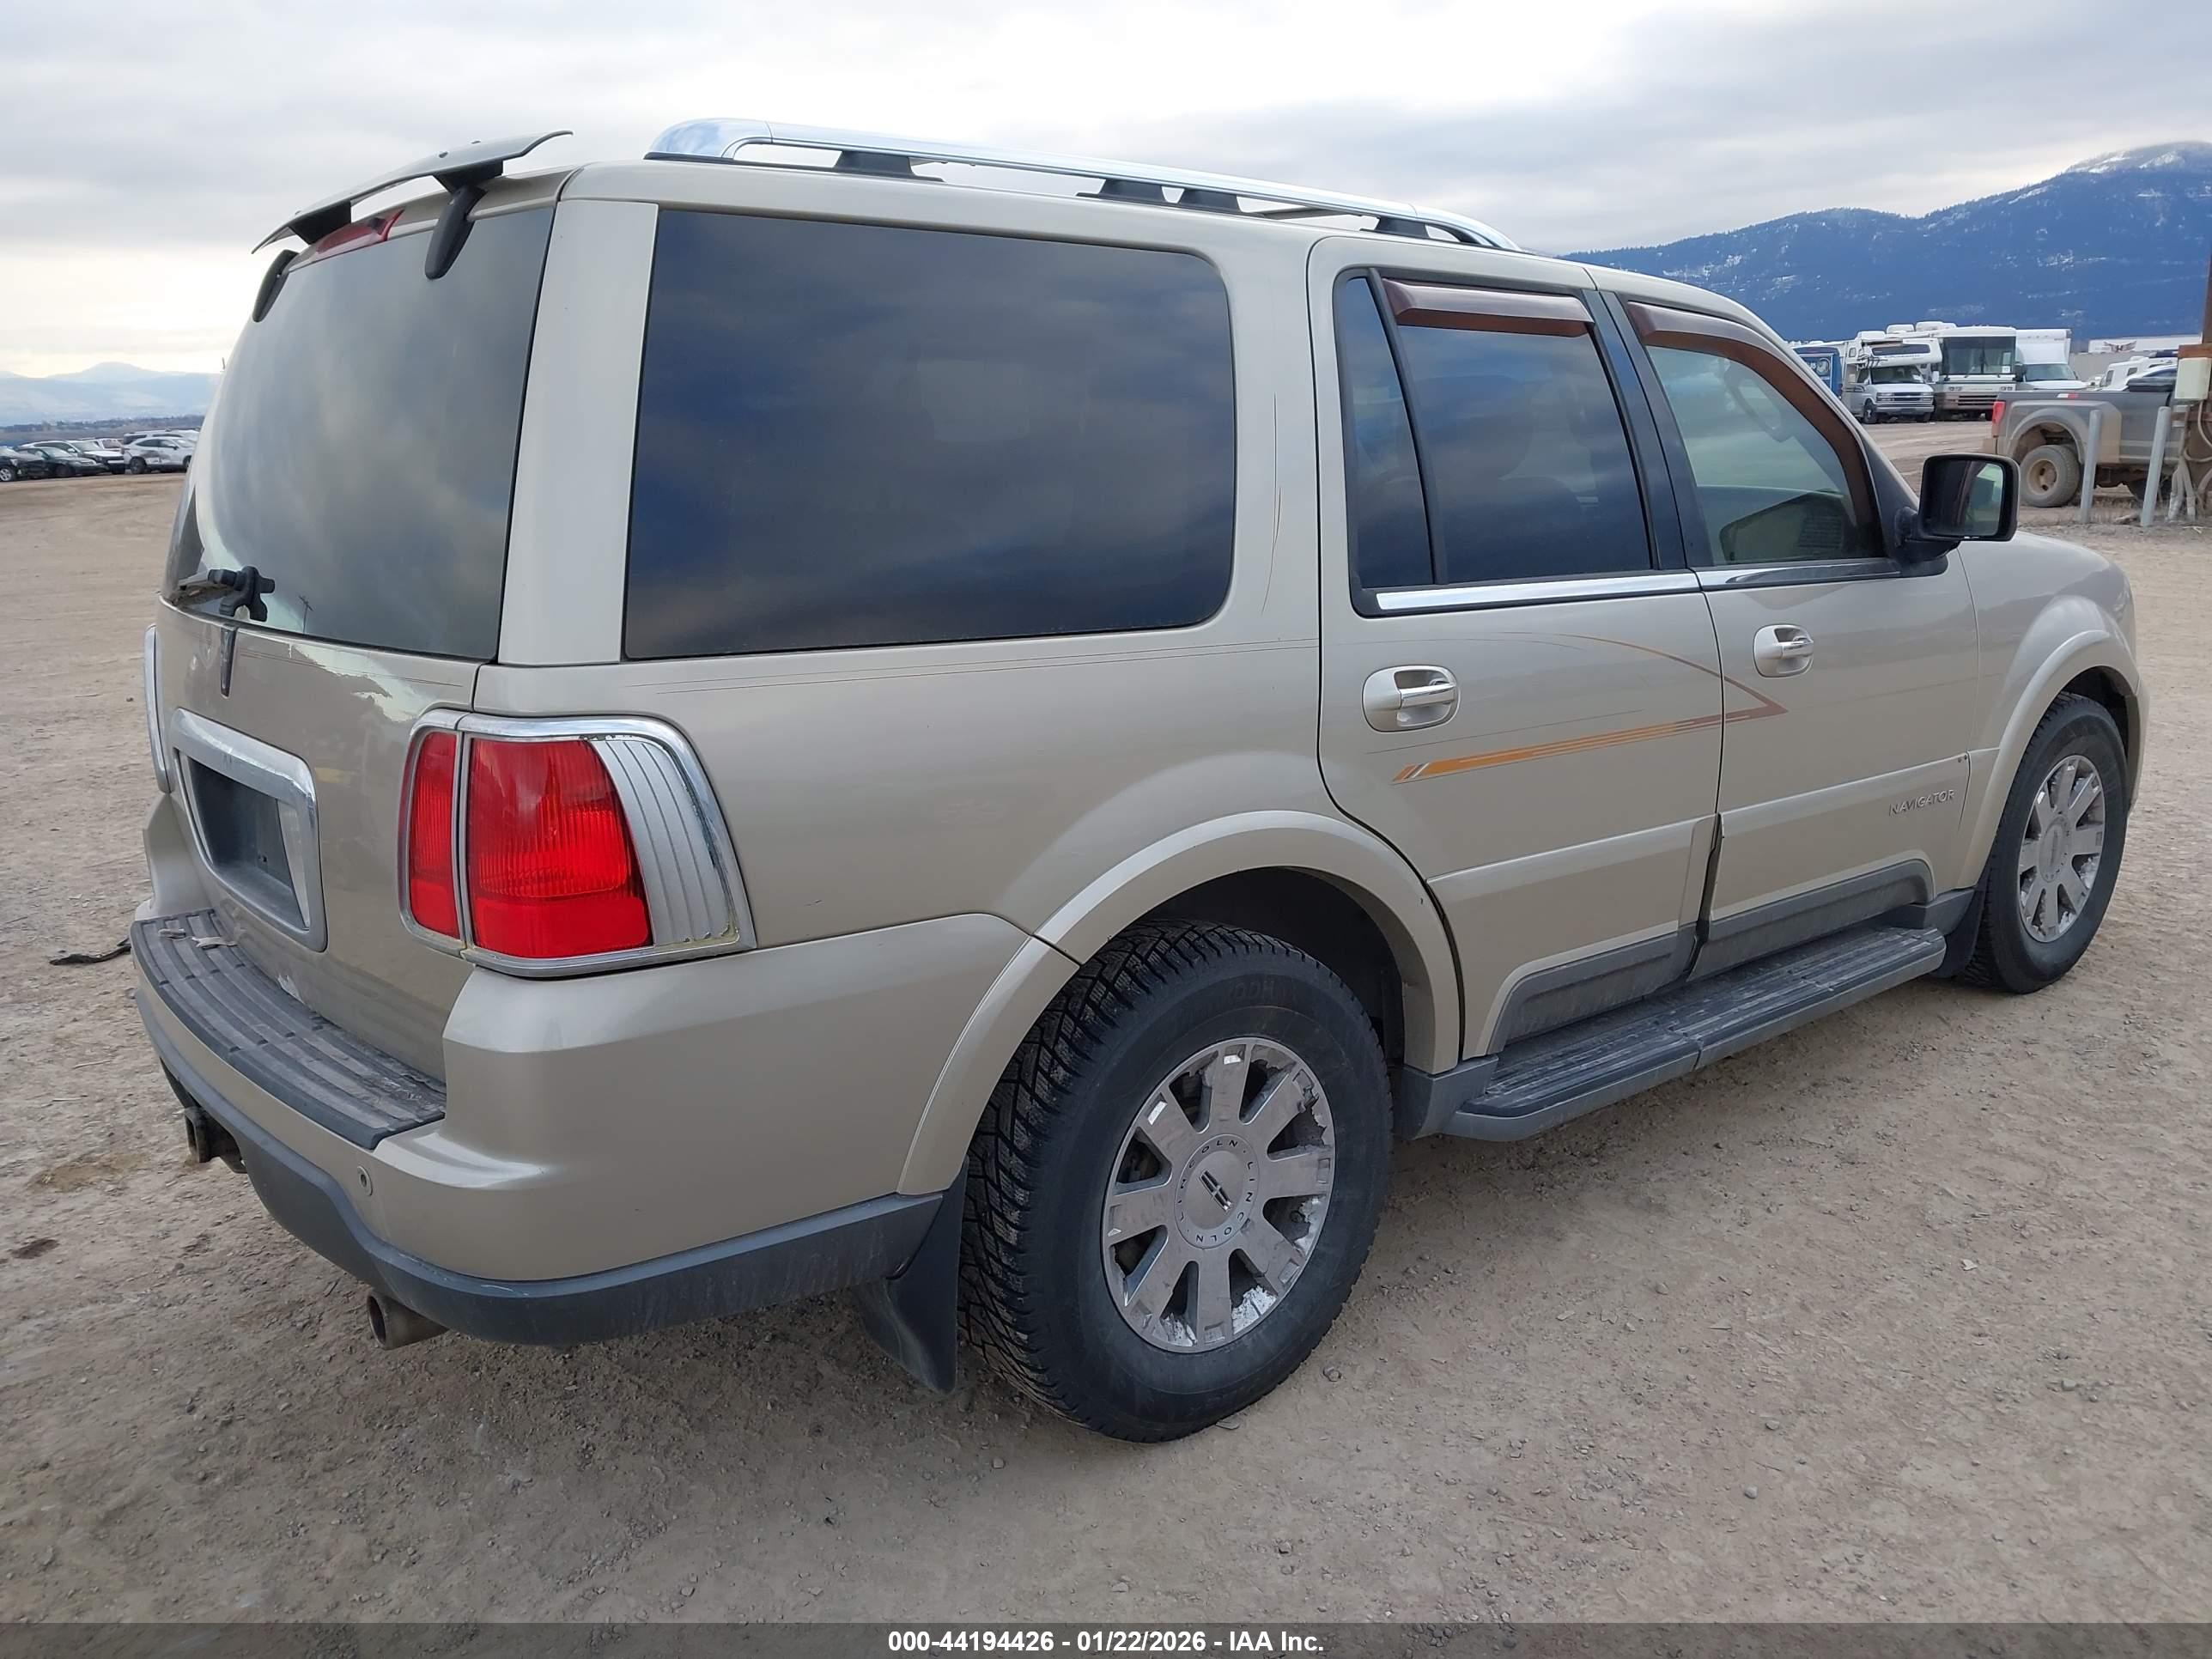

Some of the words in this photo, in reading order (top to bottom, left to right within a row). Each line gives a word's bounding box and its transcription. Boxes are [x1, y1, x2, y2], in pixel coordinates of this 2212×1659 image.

[1888, 789, 1955, 817] NAVIGATOR
[1177, 1139, 1238, 1223] LINCOLN
[1195, 1161, 1255, 1243] LINCOLN
